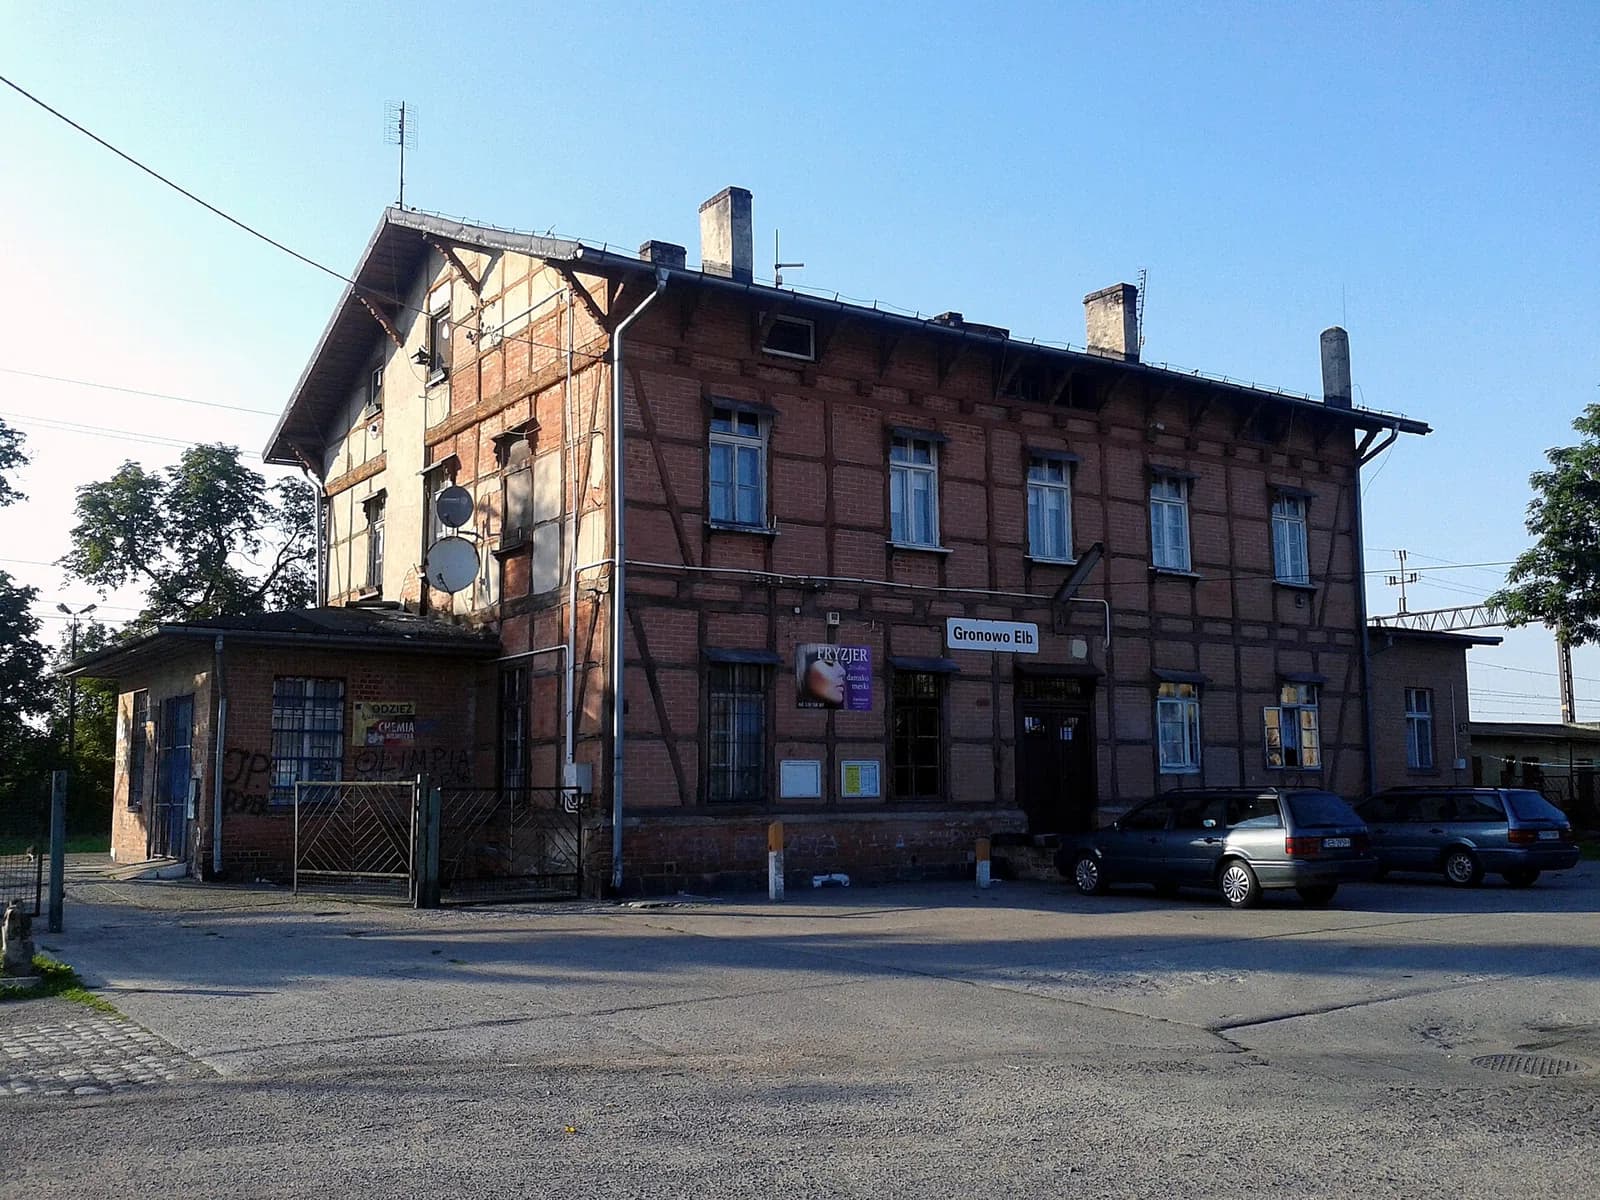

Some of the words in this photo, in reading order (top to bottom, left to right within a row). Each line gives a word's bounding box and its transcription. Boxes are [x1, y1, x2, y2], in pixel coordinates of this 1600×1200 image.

[953, 626, 1011, 643] Gronowo
[1014, 629, 1033, 645] Elb
[816, 646, 869, 664] FRYZJER
[378, 721, 415, 733] CHEMIA
[354, 747, 469, 773] OLIMPIA
